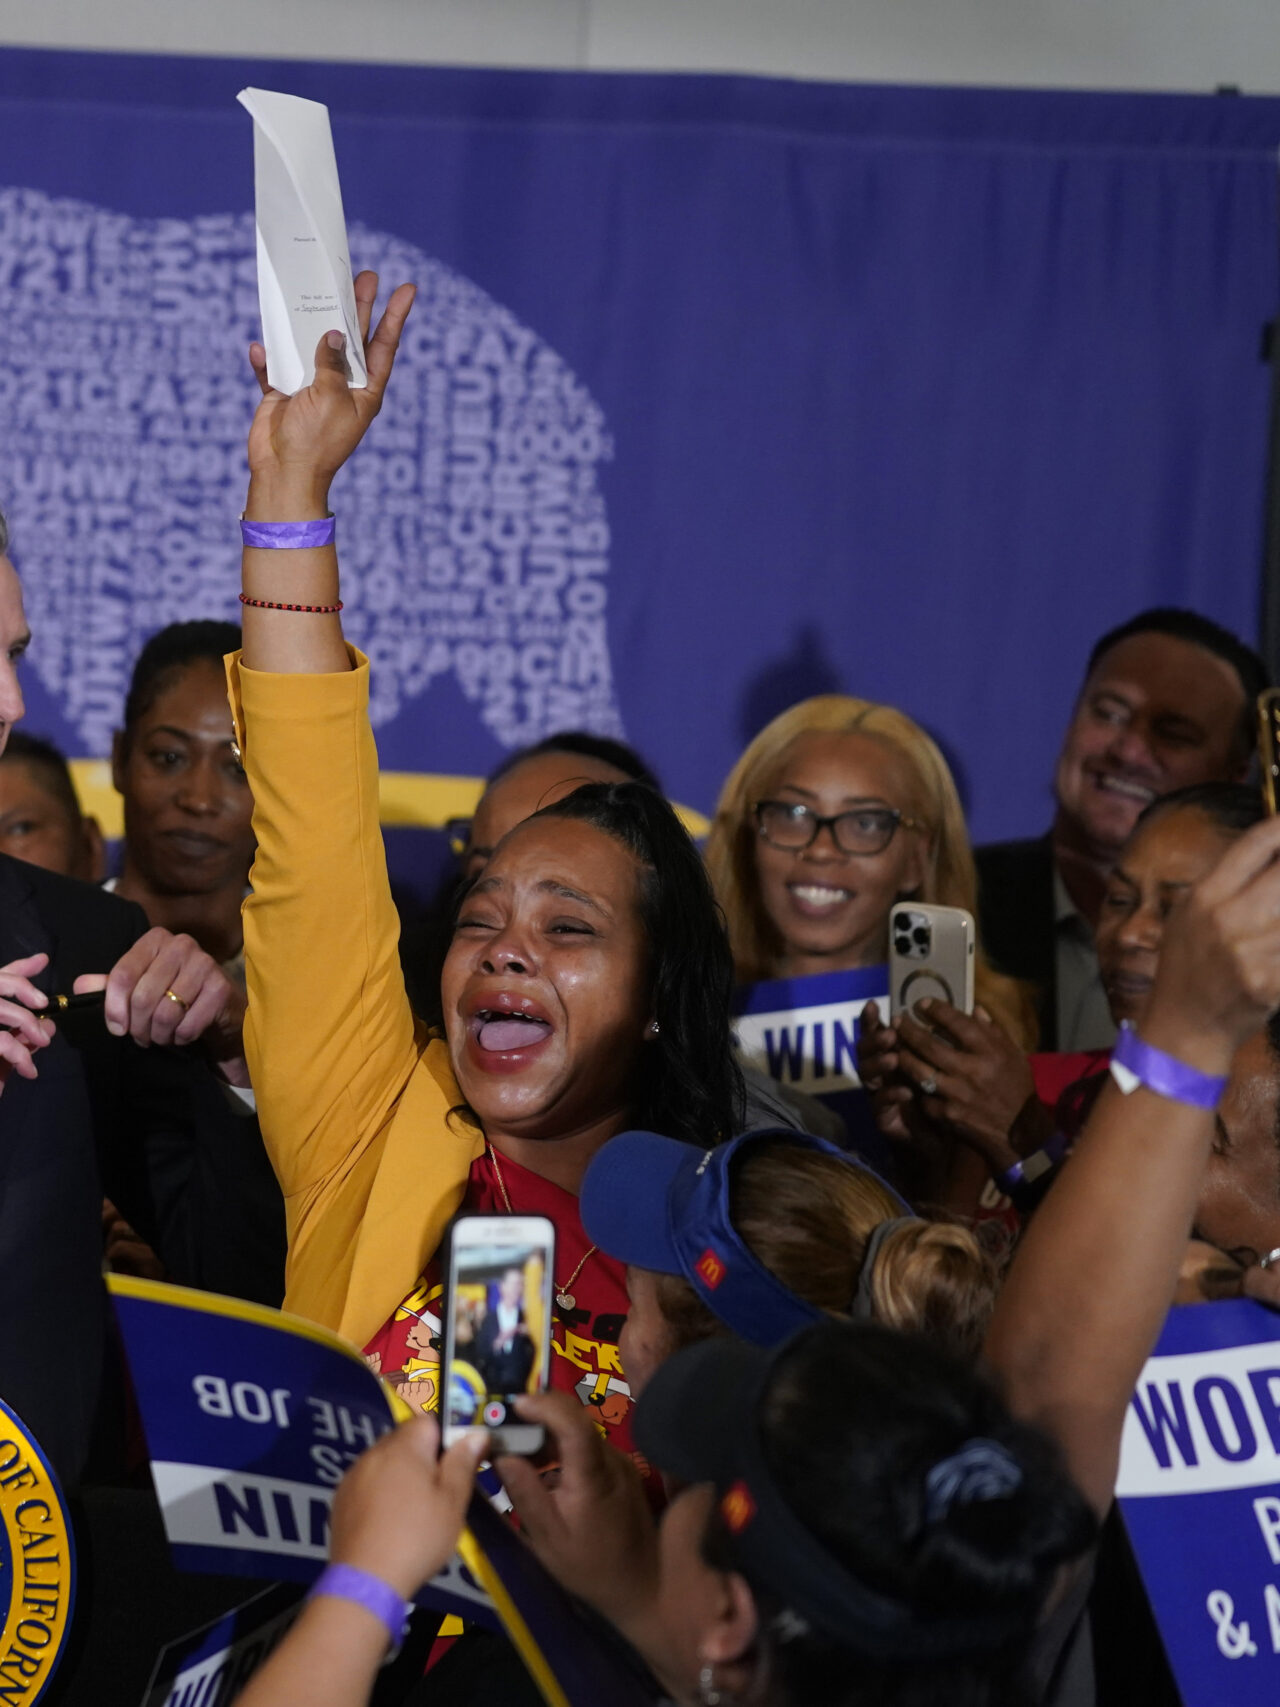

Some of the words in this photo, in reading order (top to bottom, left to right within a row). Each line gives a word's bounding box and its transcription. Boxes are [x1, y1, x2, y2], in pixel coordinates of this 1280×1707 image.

[451, 370, 492, 546] CSUEU
[492, 463, 531, 549] CIR
[532, 463, 571, 587] UHW
[764, 1016, 862, 1082] WIN
[191, 1374, 292, 1429] JOB
[1206, 1589, 1258, 1659] &
